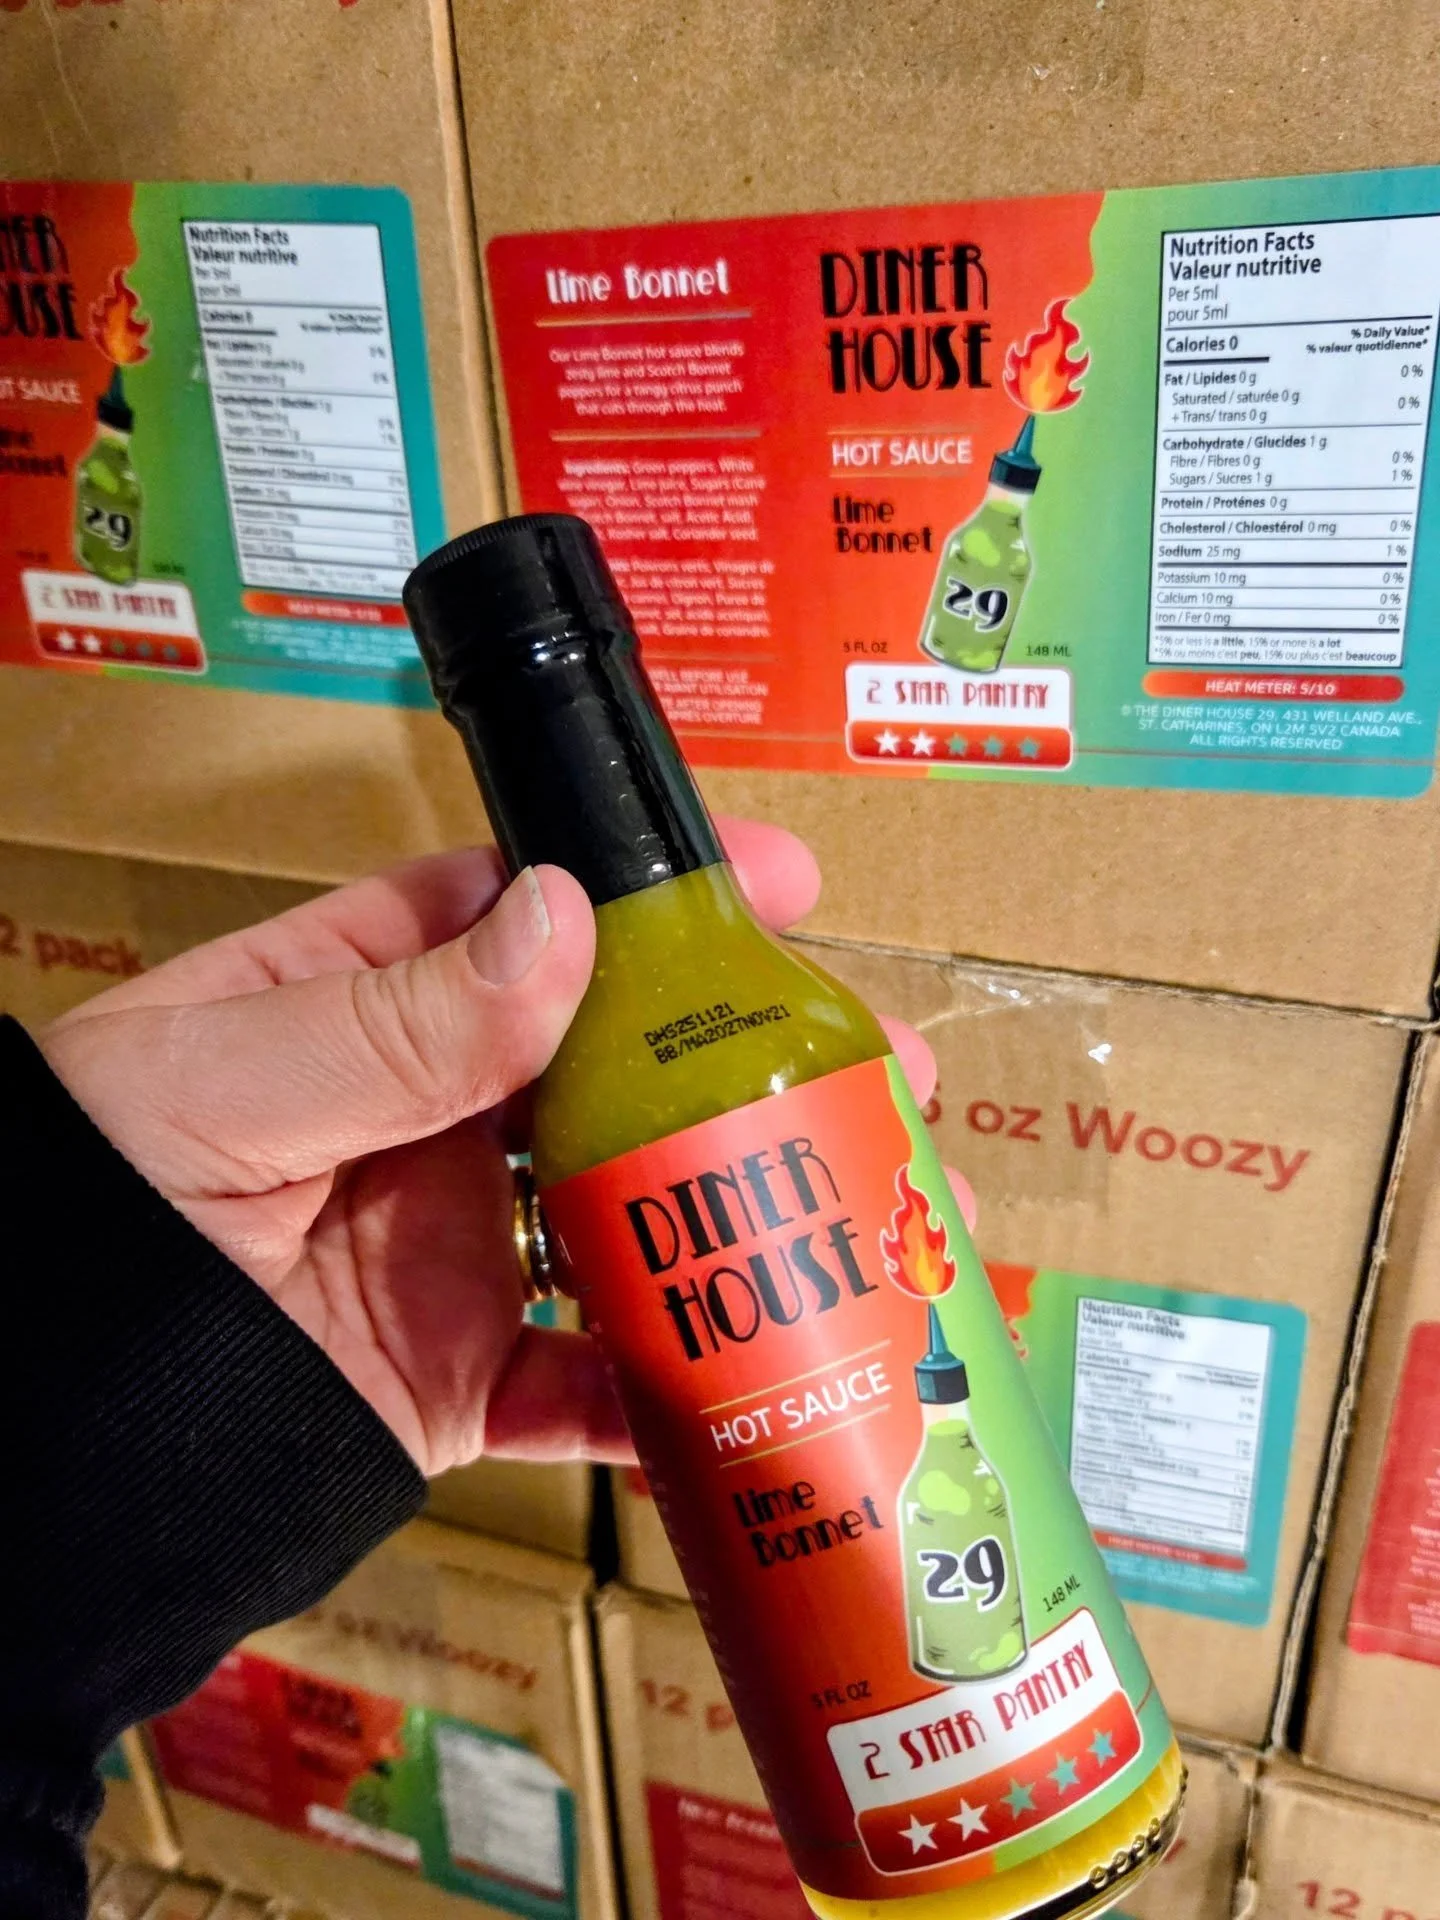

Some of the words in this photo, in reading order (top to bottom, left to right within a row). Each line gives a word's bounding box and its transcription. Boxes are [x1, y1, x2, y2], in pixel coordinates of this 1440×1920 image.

[189, 227, 250, 244] Nutrition
[255, 228, 289, 244] Facts
[1170, 236, 1258, 257] Nutrition
[1264, 232, 1314, 250] Facts
[191, 247, 234, 263] Valeur
[240, 250, 298, 266] nutritive
[1170, 260, 1230, 280] Valeur
[1236, 254, 1321, 278] nutritive
[546, 268, 612, 304] Lime
[624, 257, 730, 300] Bonnet
[820, 242, 993, 318] DINER
[1168, 286, 1189, 302] Per
[1194, 284, 1218, 300] 5ml
[1168, 308, 1199, 326] pour
[1202, 304, 1228, 320] 5ml
[1364, 327, 1391, 340] Daily
[1166, 337, 1225, 352] Calories
[1229, 336, 1238, 350] 0
[1319, 342, 1352, 353] valeur
[827, 320, 992, 393] HOUSE
[1164, 374, 1182, 385] Fat
[1193, 372, 1236, 387] Lipides
[1249, 374, 1256, 386] g
[1402, 365, 1409, 377] 0
[1412, 365, 1423, 376] %
[1172, 392, 1226, 405] Saturated
[1292, 392, 1300, 404] g
[1398, 397, 1406, 408] 0
[1408, 396, 1420, 408] %
[1218, 411, 1246, 421] trans
[1259, 412, 1267, 423] g
[832, 441, 882, 465] HOT
[889, 437, 972, 464] SAUCE
[1163, 438, 1244, 451] Carbohydrate
[1254, 436, 1306, 448] Glucides
[1319, 438, 1327, 450] g
[1170, 456, 1197, 467] Fibre
[1208, 454, 1240, 467] Fibres
[1253, 457, 1260, 468] g
[1392, 452, 1399, 463] 0
[1402, 452, 1414, 463] %
[1170, 473, 1206, 487] Sugars
[1216, 472, 1252, 484] Sucres
[1264, 474, 1272, 486] g
[832, 496, 894, 524] Lime
[1161, 497, 1203, 510] Protein
[1280, 498, 1288, 510] g
[1160, 522, 1226, 534] Cholesterol
[1318, 523, 1336, 536] mg
[1390, 520, 1397, 532] 0
[1400, 521, 1411, 532] %
[836, 526, 932, 552] Bonnet
[1158, 546, 1202, 557] Sodium
[1207, 546, 1220, 557] 25
[1222, 548, 1240, 559] mg
[1158, 572, 1210, 584] Potassium
[1214, 572, 1226, 584] 10
[1228, 574, 1246, 586] mg
[1383, 572, 1390, 583] 0
[1392, 572, 1404, 583] %
[943, 576, 1008, 633] 29
[1157, 592, 1198, 604] Calcium
[1202, 593, 1212, 604] 10
[1216, 595, 1233, 606] mg
[1155, 612, 1176, 624] Iron
[1185, 612, 1202, 624] Fer
[1212, 614, 1231, 626] mg
[854, 642, 868, 653] FL
[872, 642, 888, 652] OZ
[1026, 645, 1049, 656] 148
[1054, 646, 1072, 656] ML
[866, 680, 882, 704] 2
[895, 680, 950, 704] STAR
[963, 681, 1049, 709] PANTRY
[1206, 681, 1241, 694] HEAT
[1245, 681, 1296, 694] METER:
[1135, 705, 1158, 717] THE
[1162, 706, 1203, 718] DINER
[1207, 706, 1254, 720] HOUSE
[1282, 710, 1309, 721] 431
[1314, 710, 1384, 723] WELLAND
[1251, 721, 1269, 734] ON
[1340, 724, 1400, 736] CANADA
[1190, 733, 1215, 746] ALL
[1218, 735, 1268, 748] RIGHTS
[1270, 736, 1342, 750] RESERVED
[966, 1100, 1042, 1142] oz
[1066, 1101, 1310, 1192] Woozy
[624, 1138, 840, 1274] DINER
[664, 1218, 880, 1361] HOUSE
[710, 1408, 773, 1452] HOT
[780, 1363, 892, 1429] SAUCE
[732, 1480, 816, 1528] Lime
[752, 1494, 884, 1567] Bonnet
[916, 1534, 1009, 1612] 29
[1043, 1586, 1065, 1612] 148
[1064, 1575, 1080, 1595] ML
[846, 1680, 871, 1701] OZ
[860, 1742, 890, 1780] 2
[899, 1709, 987, 1770] STAR
[992, 1640, 1094, 1732] PANTRY
[1297, 1881, 1362, 1918] 12
